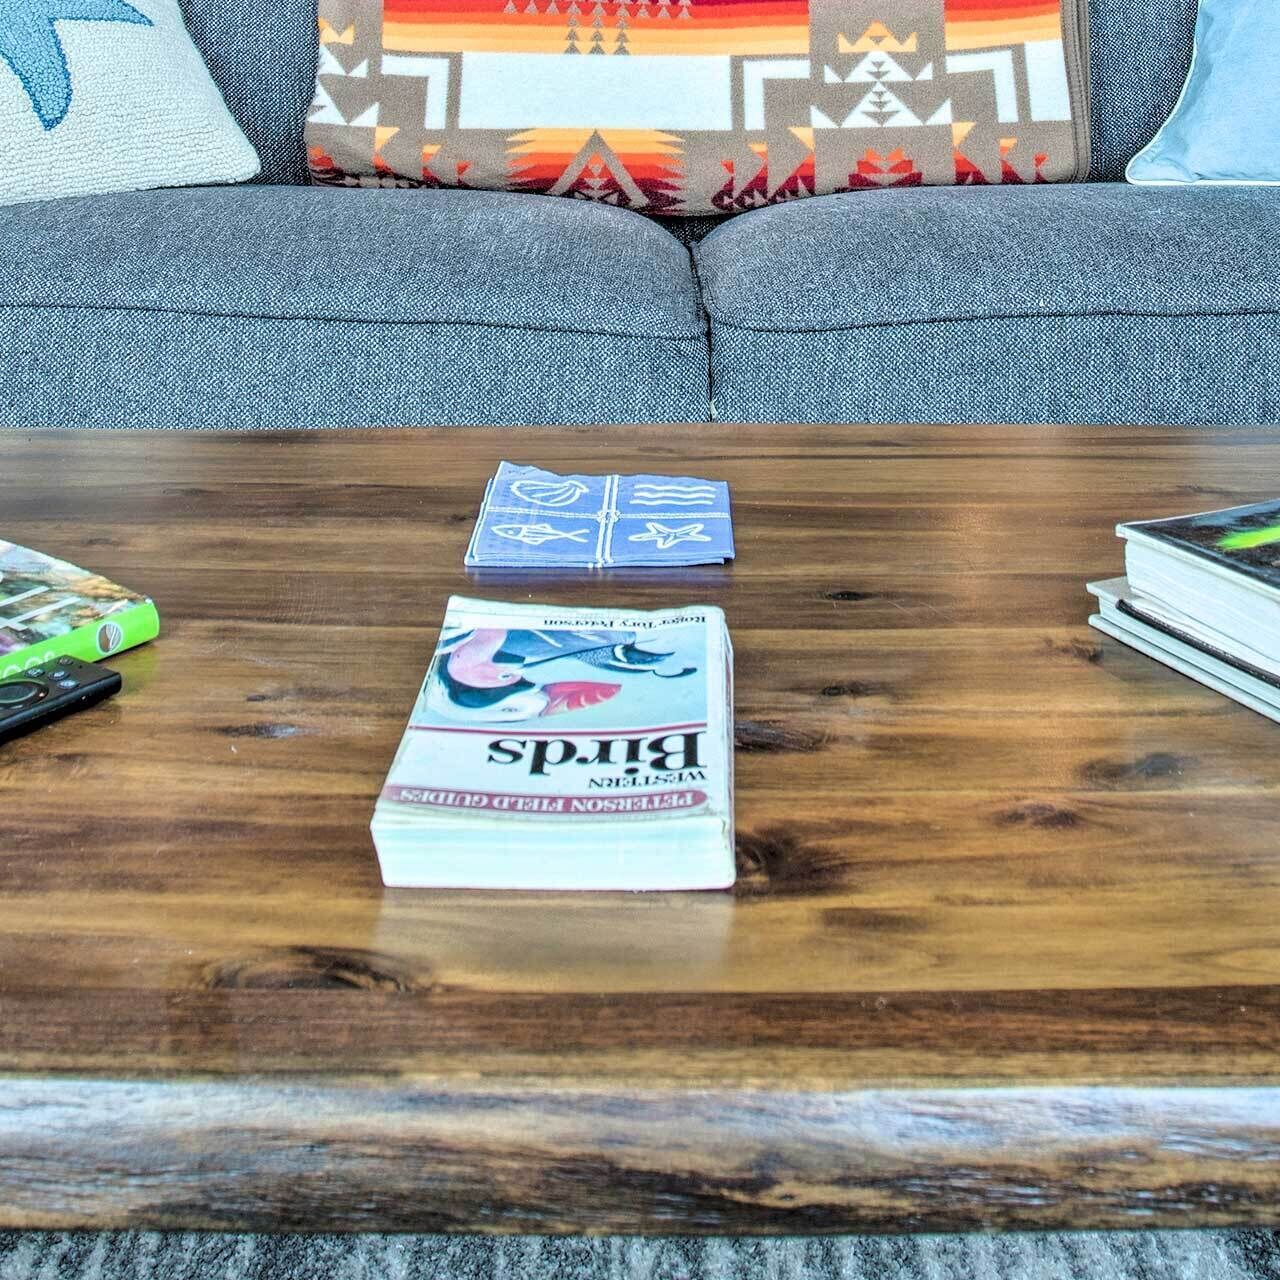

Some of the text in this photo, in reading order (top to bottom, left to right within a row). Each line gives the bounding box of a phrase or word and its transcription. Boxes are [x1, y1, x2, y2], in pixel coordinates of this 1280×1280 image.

[543, 615, 706, 629] Roger Tory Peterson
[486, 731, 708, 776] Birds
[587, 770, 708, 789] WESTERN
[399, 789, 695, 813] PETERSON FIELD GUIDES
